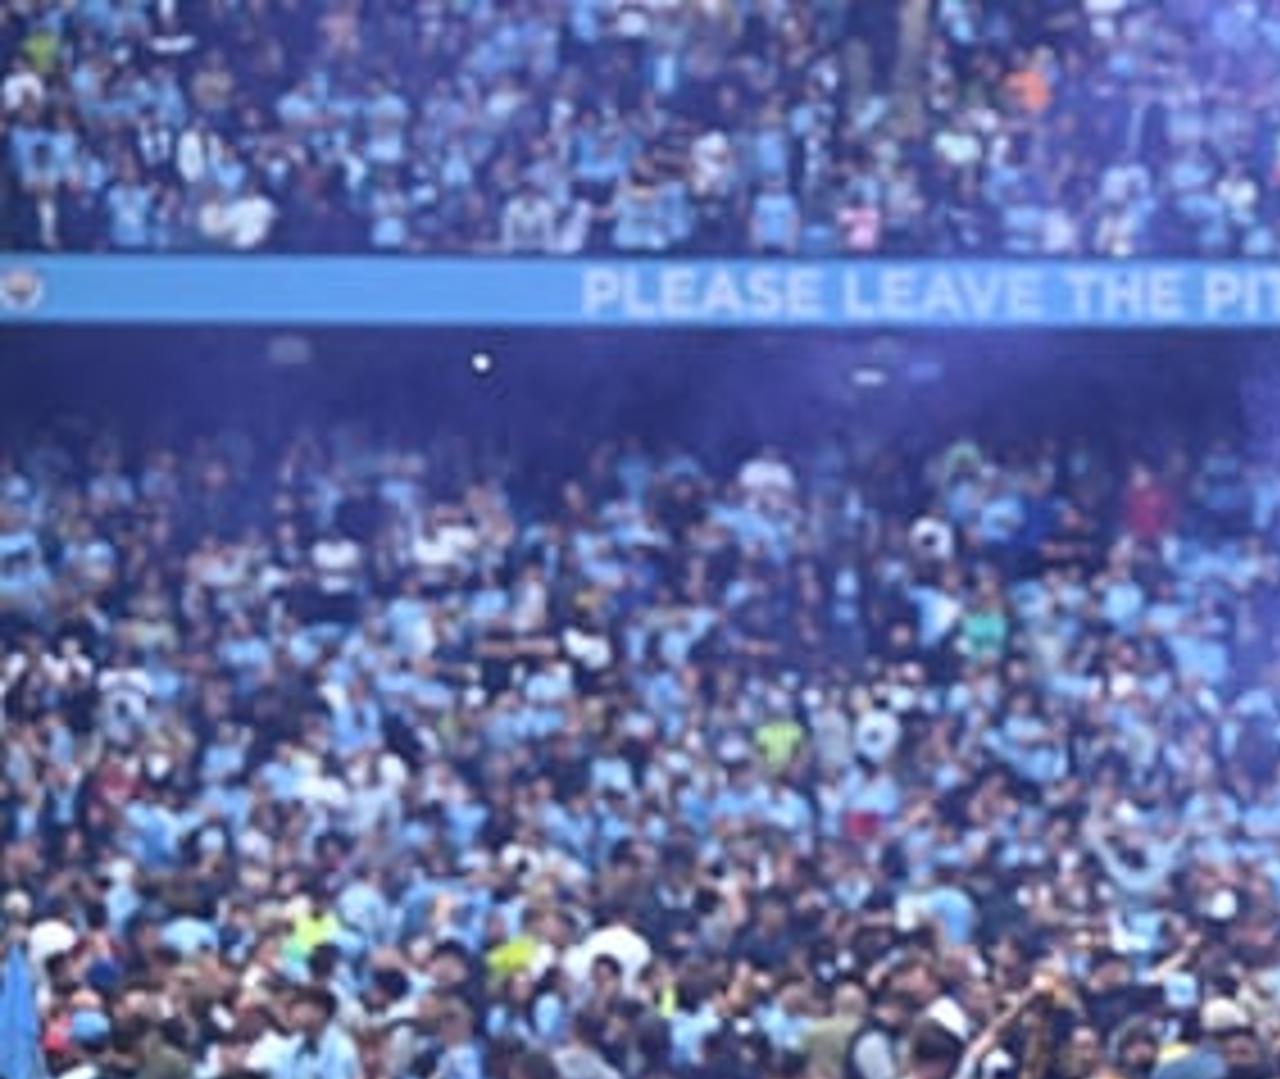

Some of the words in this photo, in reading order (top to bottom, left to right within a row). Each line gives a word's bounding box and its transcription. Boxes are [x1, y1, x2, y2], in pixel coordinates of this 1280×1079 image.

[582, 270, 825, 318] PLEASE
[842, 270, 1046, 318] LEAVE
[1064, 270, 1185, 318] THE
